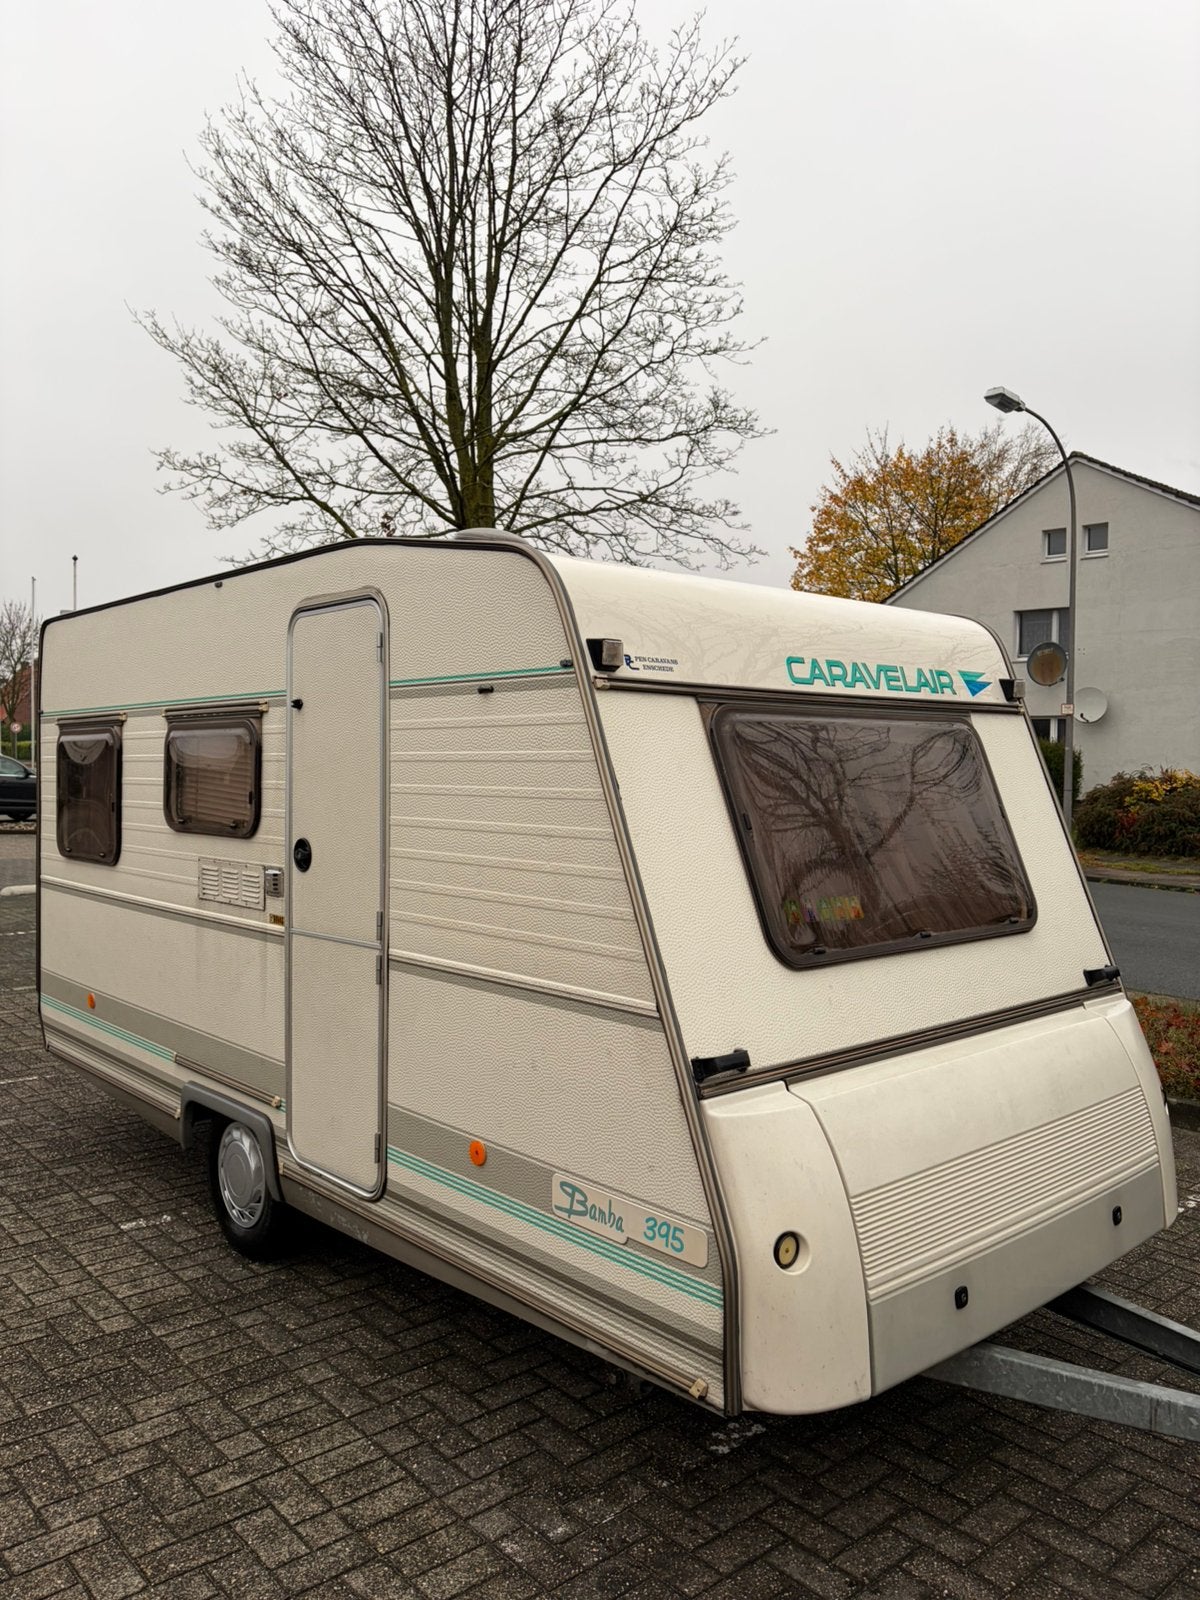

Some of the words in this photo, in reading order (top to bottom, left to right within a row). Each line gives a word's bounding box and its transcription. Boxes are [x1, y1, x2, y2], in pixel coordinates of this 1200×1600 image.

[642, 664, 674, 672] ENSCHEDE
[648, 657, 678, 665] CARAVANS
[786, 656, 957, 695] CARAVELAIR
[555, 1181, 624, 1233] Bamba
[643, 1217, 685, 1254] 395
